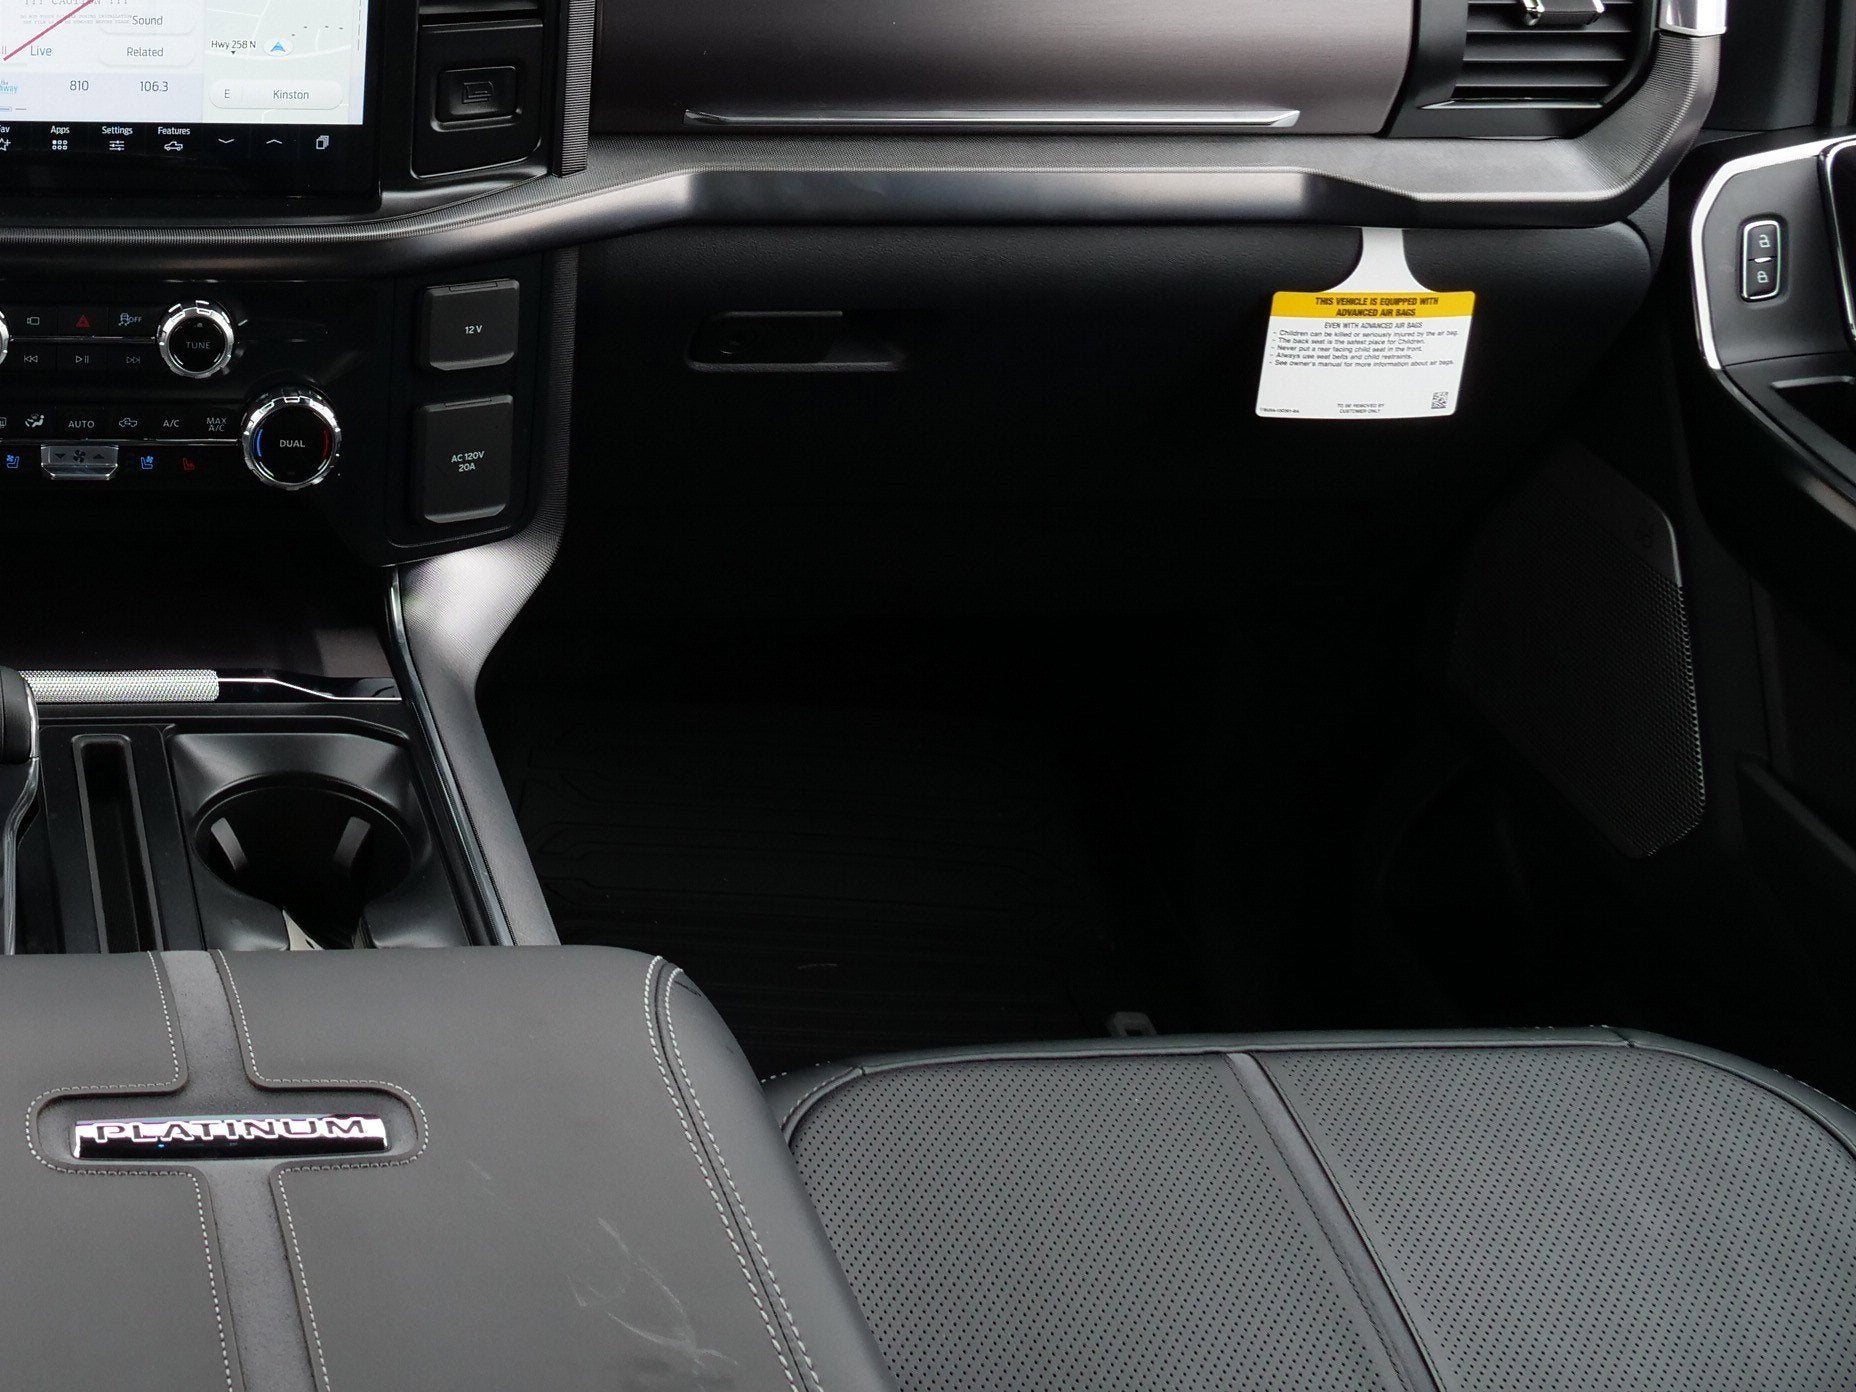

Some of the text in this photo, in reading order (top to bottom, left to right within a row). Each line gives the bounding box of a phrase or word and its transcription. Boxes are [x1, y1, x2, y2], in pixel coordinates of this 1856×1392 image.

[132, 14, 164, 26] Sound
[210, 39, 257, 51] Hwy 258 N
[29, 45, 53, 57] Live
[125, 46, 165, 57] Related
[69, 80, 90, 92] 810
[139, 80, 169, 93] 106.3
[223, 89, 231, 100] E
[272, 89, 310, 101] Kinston
[50, 124, 71, 136] Apps
[101, 125, 134, 137] Settings
[157, 126, 191, 136] Features
[1315, 297, 1439, 306] THIS VEHICLE IS EQUIPPED WITH
[1335, 308, 1416, 317] ADVANCED AIR BAGS
[129, 315, 143, 323] OFF
[464, 324, 483, 335] 12 V
[1406, 321, 1424, 329] BAGS
[1279, 329, 1309, 337] Children
[1394, 331, 1415, 339] injured
[1416, 331, 1424, 339] by
[185, 341, 211, 349] TUNE
[68, 419, 95, 429] AUTO
[163, 419, 180, 428] A/C
[206, 417, 227, 425] MAX
[279, 439, 306, 448] DUAL
[450, 451, 485, 463] AC 120V
[458, 462, 476, 473] 20A
[94, 1118, 368, 1144] PLATINUM
